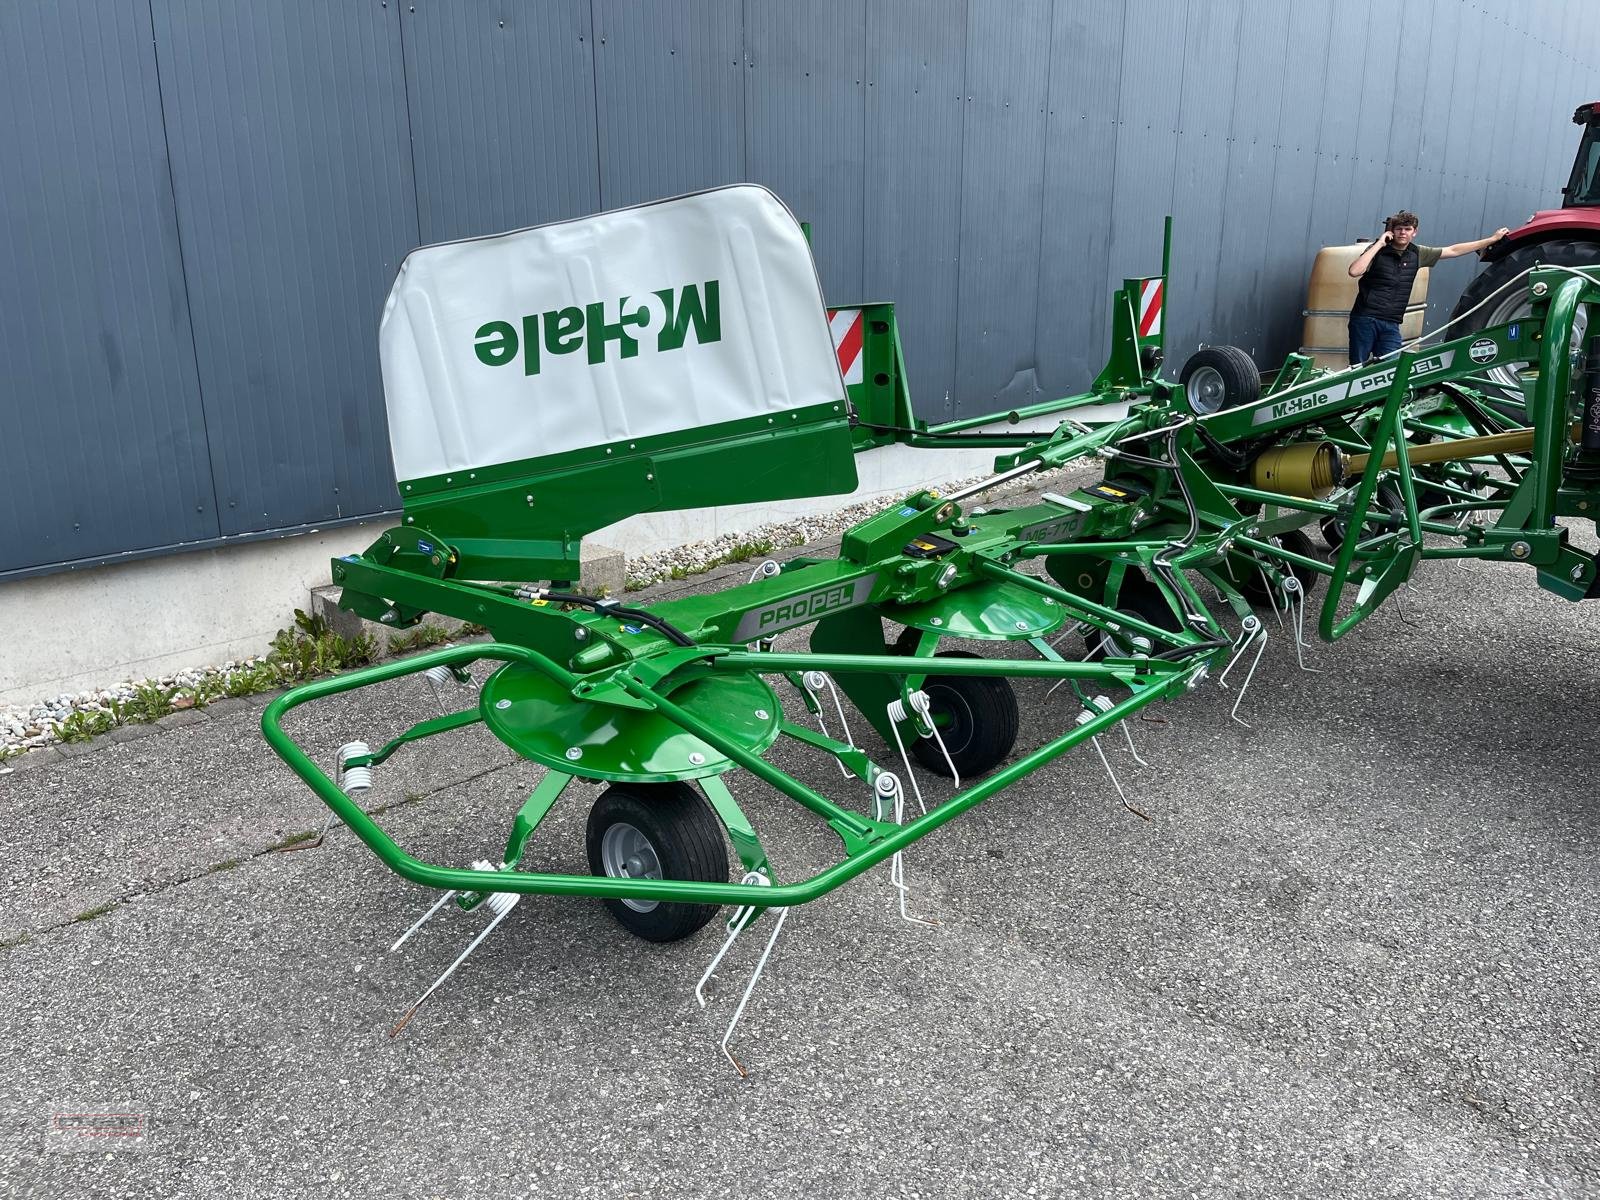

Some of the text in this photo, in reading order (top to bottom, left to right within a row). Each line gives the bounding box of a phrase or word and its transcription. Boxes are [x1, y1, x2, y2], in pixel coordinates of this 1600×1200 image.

[474, 280, 721, 376] McHale
[1272, 394, 1328, 418] McHale
[760, 583, 855, 629] PROPEL
